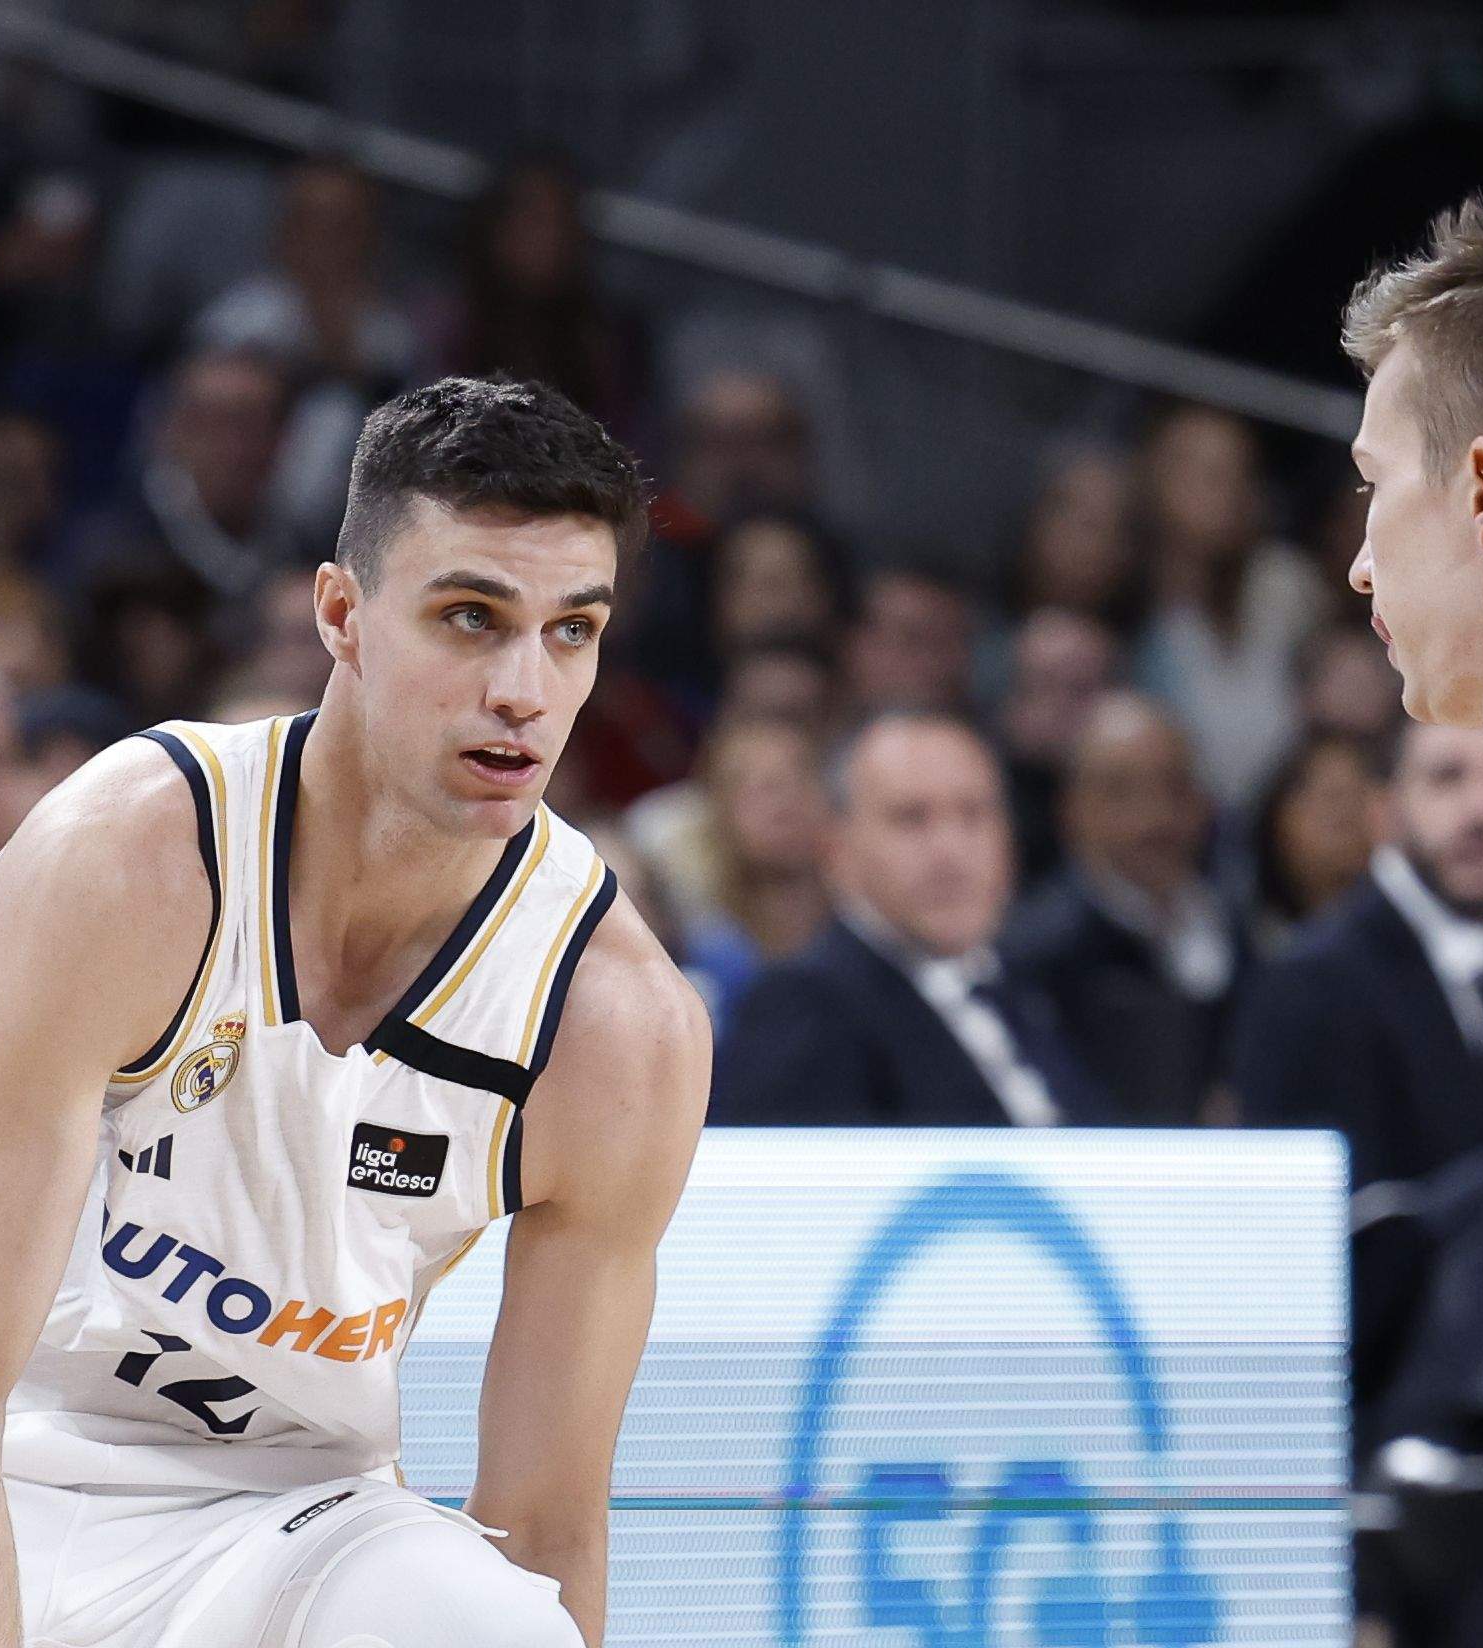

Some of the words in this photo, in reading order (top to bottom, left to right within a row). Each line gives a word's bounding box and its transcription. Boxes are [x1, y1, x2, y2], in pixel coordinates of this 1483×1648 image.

[355, 1142, 397, 1167] liga
[351, 1165, 436, 1190] endesa
[101, 1200, 407, 1363] UTOHER
